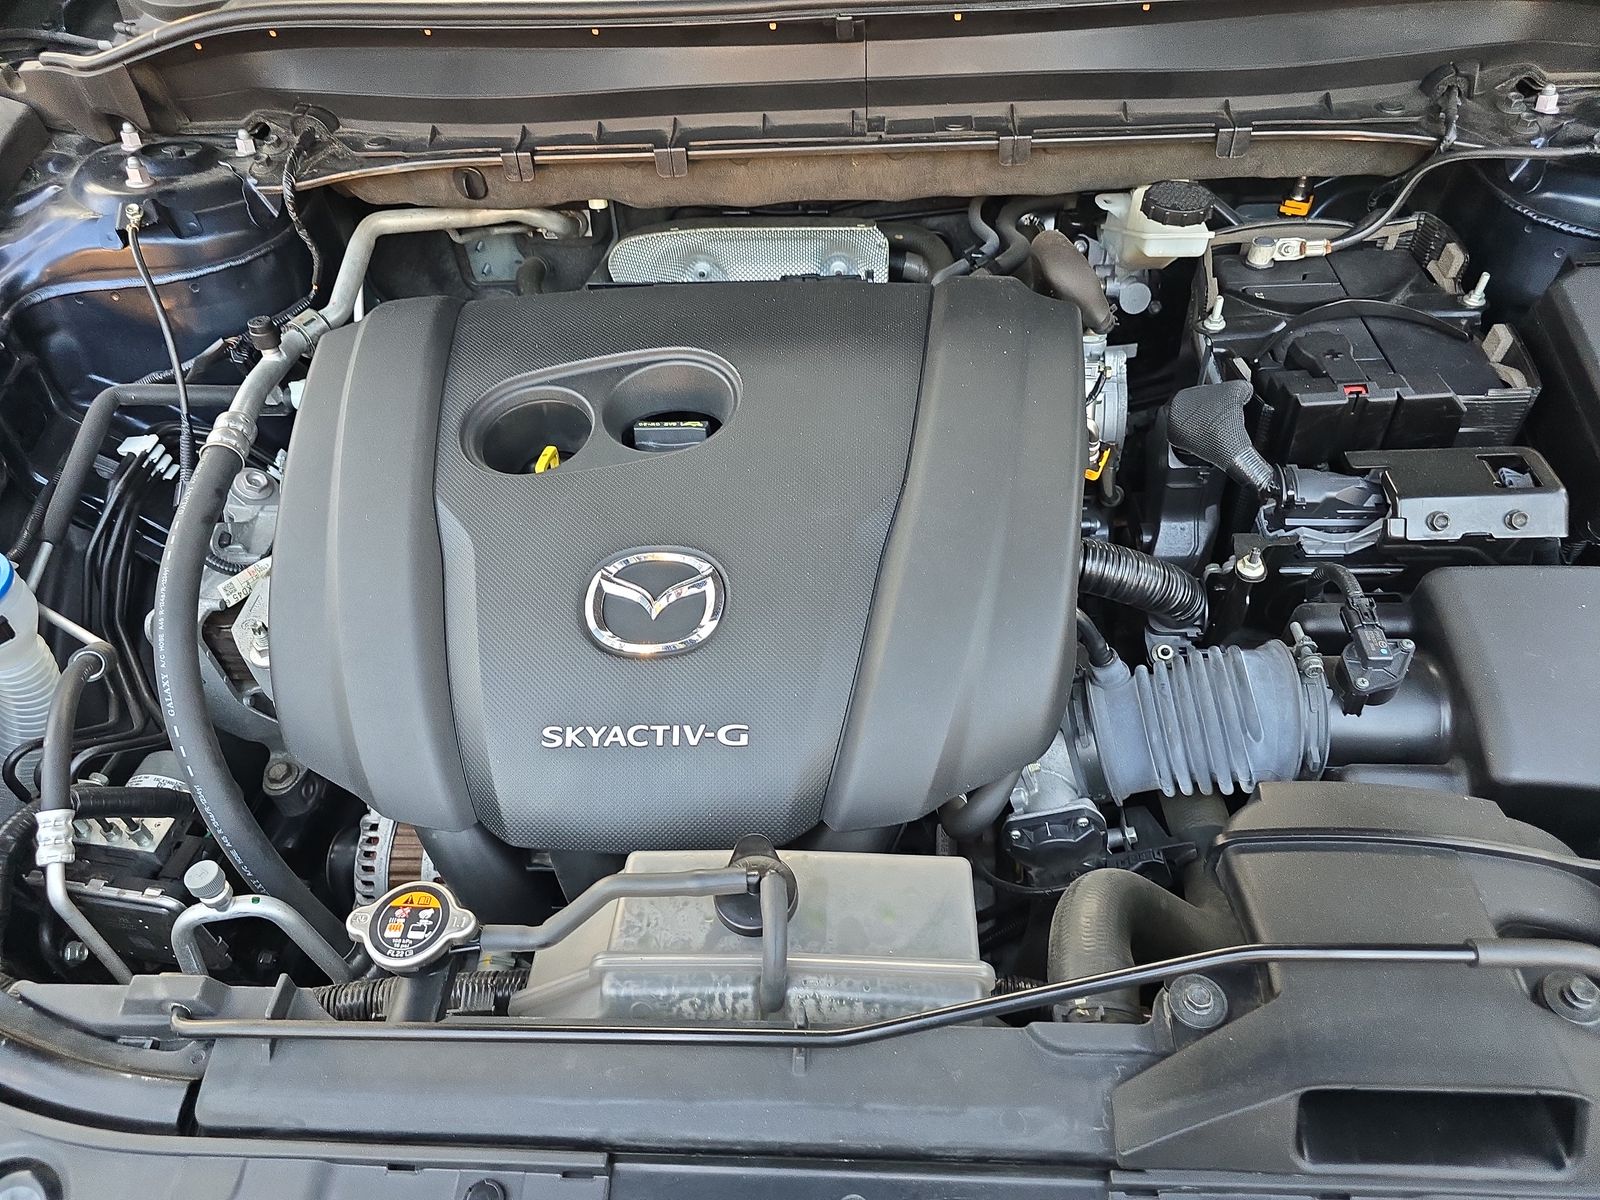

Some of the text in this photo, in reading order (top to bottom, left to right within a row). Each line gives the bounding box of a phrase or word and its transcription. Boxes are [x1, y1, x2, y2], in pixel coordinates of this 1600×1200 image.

[161, 673, 176, 717] GALAXY
[540, 723, 750, 748] SKYACTIV-G
[386, 949, 405, 957] FL22
